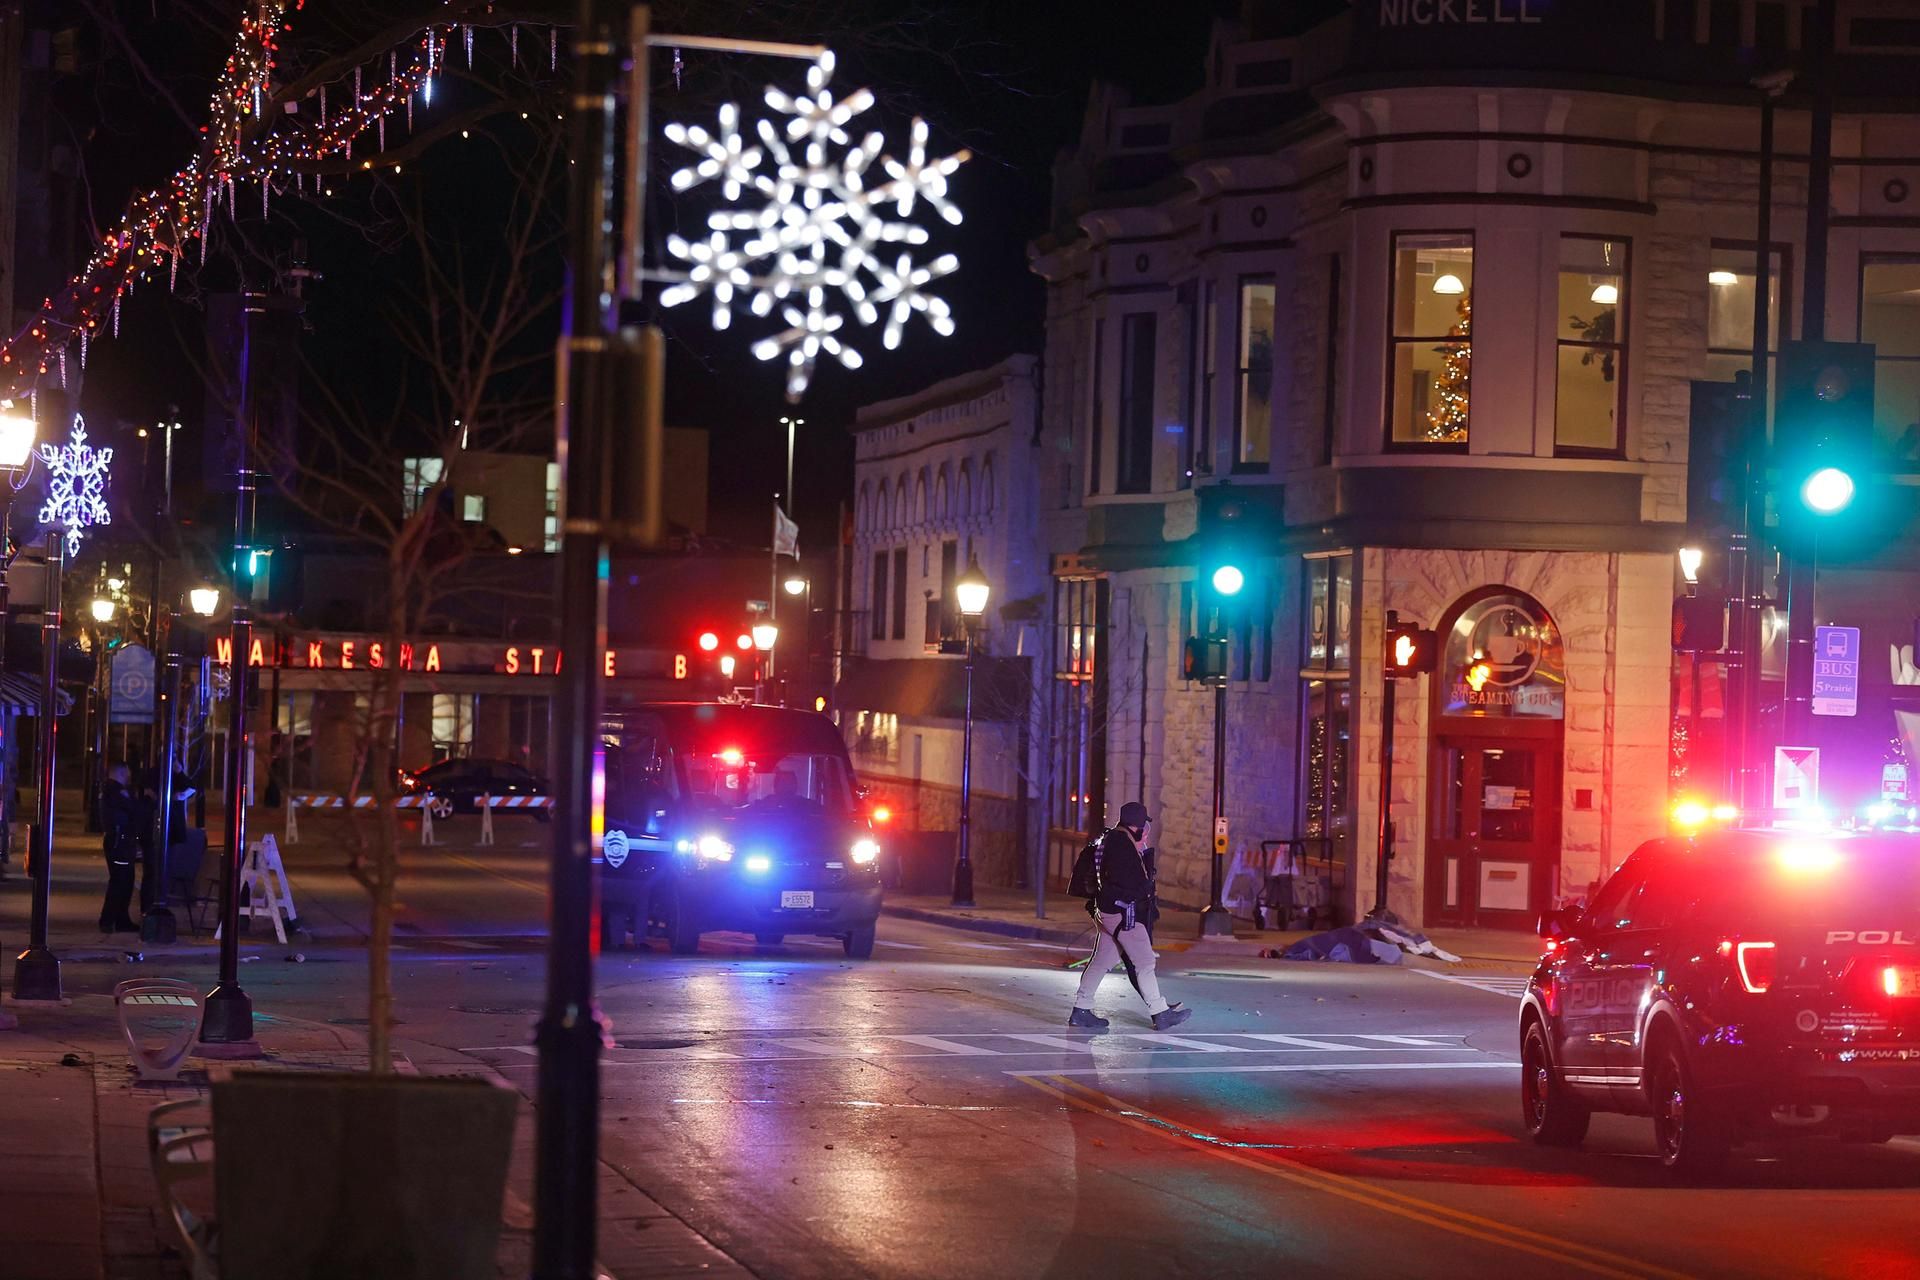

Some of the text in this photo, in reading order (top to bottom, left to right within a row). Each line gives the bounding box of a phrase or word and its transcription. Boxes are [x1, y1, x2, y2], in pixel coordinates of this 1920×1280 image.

[1379, 0, 1542, 26] NICKELL
[1820, 662, 1852, 675] BUS
[1816, 681, 1854, 693] 5 Prairie
[1450, 689, 1525, 705] STEAMING
